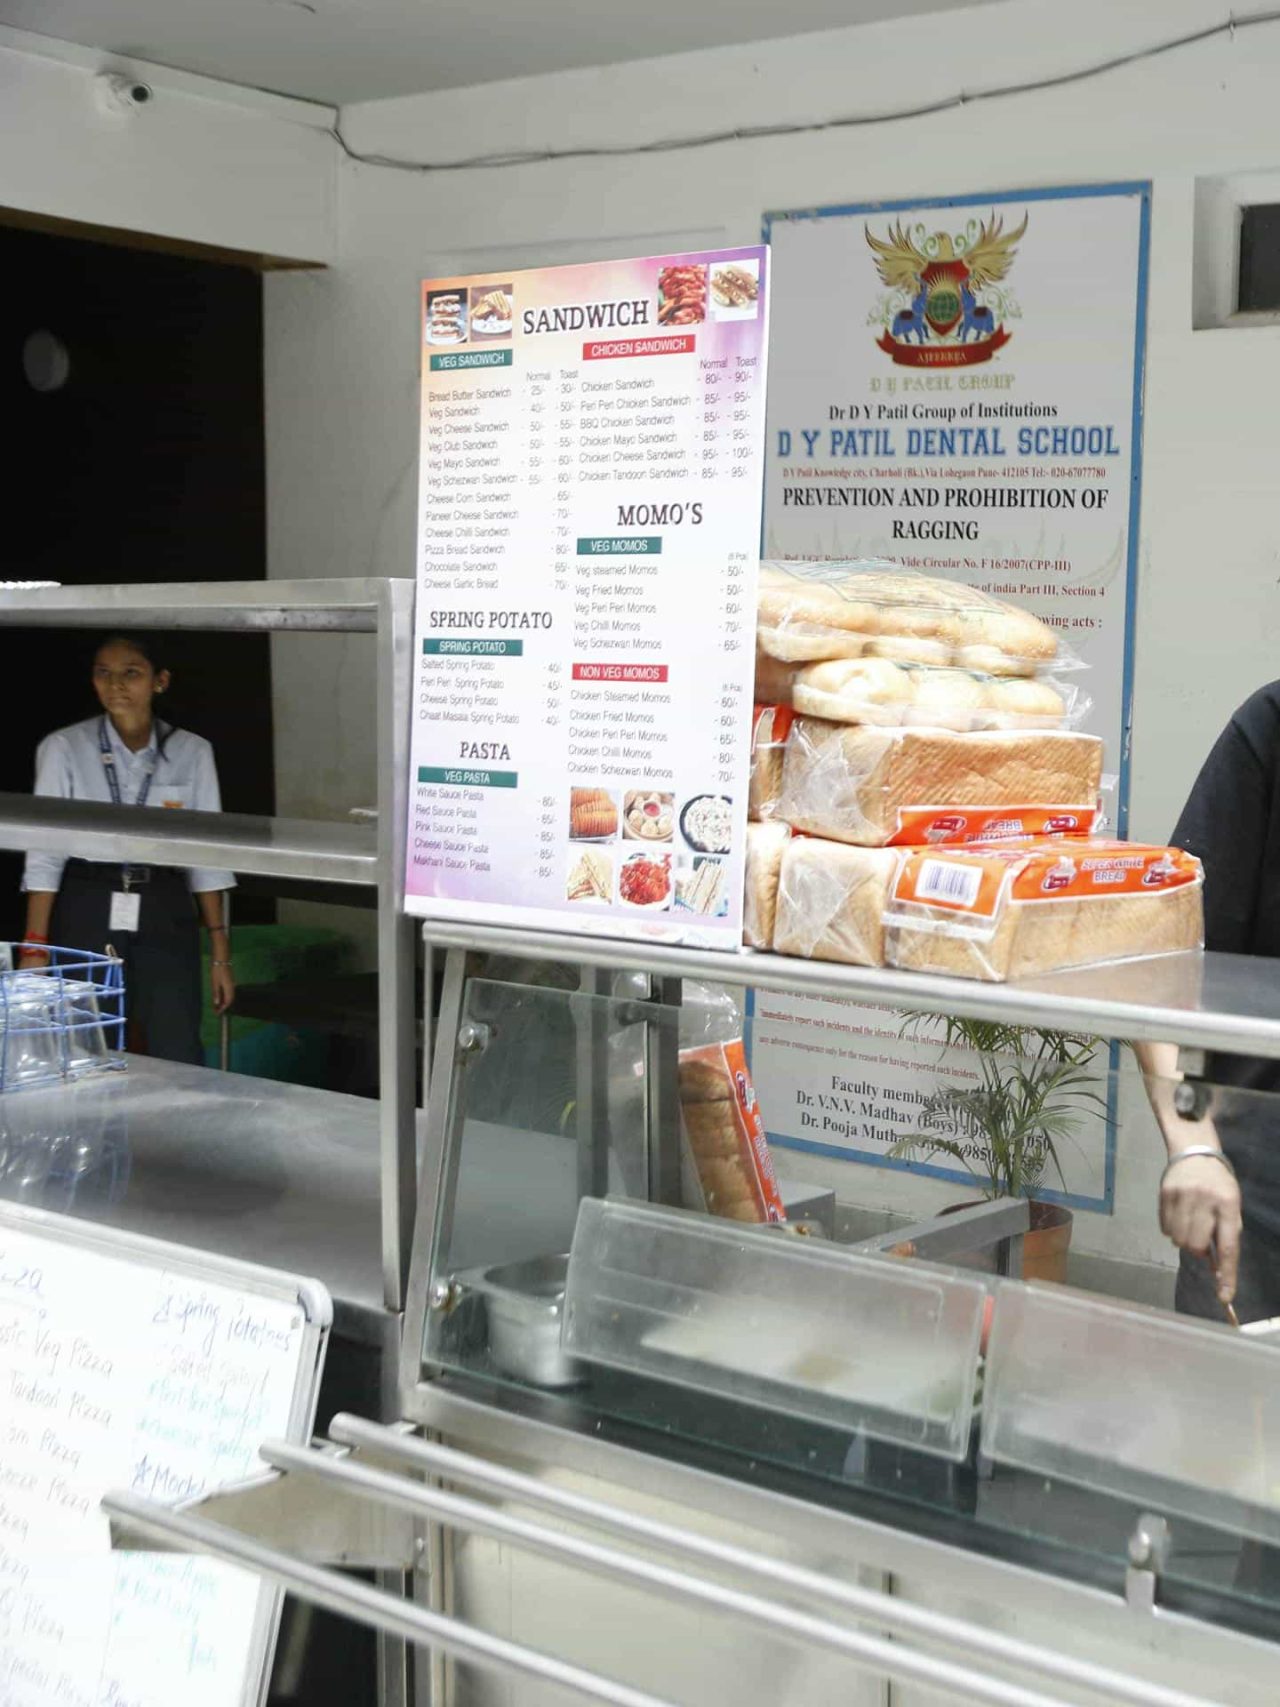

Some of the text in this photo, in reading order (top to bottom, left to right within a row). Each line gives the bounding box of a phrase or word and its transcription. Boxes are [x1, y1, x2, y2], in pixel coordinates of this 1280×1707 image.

[523, 301, 649, 334] SANDWICH
[591, 338, 687, 358] CHICKEN SANDWICH
[439, 352, 506, 369] VEG SANDWICH
[700, 356, 757, 370] Normal Toast
[581, 379, 655, 392] Chicken Sandwich
[616, 398, 648, 409] Chicken
[651, 396, 691, 407] Sandwich
[829, 402, 1058, 422] Dr D Y Patil Group of Institutions
[601, 417, 633, 428] Chicken
[635, 414, 675, 426] Sandwich
[580, 435, 611, 447] Chicken
[638, 432, 678, 444] Sandwich
[777, 425, 1120, 457] D Y PATIL DENTAL SCHOOL
[579, 449, 687, 464] Chicken Cheese Sandwich
[579, 470, 611, 482] Chicken
[649, 467, 689, 479] Sandwich
[783, 487, 1109, 509] PREVENTION AND PROHIBITION OF
[617, 502, 703, 526] MOMO'S
[892, 520, 979, 541] RAGGING
[591, 539, 648, 552] VEG MOMOS
[629, 564, 659, 576] Momos
[901, 557, 921, 568] Vide
[923, 557, 961, 569] Circular
[592, 584, 612, 595] Fried
[614, 584, 644, 595] Momos
[982, 583, 993, 593] of
[993, 583, 1017, 594] india
[1020, 584, 1041, 595] Part
[1061, 585, 1097, 597] Section
[1099, 586, 1105, 596] 4
[627, 602, 657, 614] Momos
[430, 611, 553, 629] SPRING POTATO
[611, 620, 641, 631] Momos
[1072, 615, 1096, 628] acts
[439, 641, 506, 654] SPRING POTATO
[633, 638, 662, 650] Momos
[580, 666, 660, 680] NON VEG MOMOS
[570, 690, 601, 701] Chicken
[641, 692, 671, 704] Momos
[459, 741, 511, 760] PASTA
[444, 771, 491, 784] VEG PASTA
[832, 1076, 880, 1101] Faculty
[796, 1090, 815, 1106] Dr.
[819, 1094, 856, 1114] V.N.V.
[860, 1102, 913, 1124] Madhav
[801, 1112, 820, 1128] Dr.
[823, 1116, 857, 1138] Pooja
